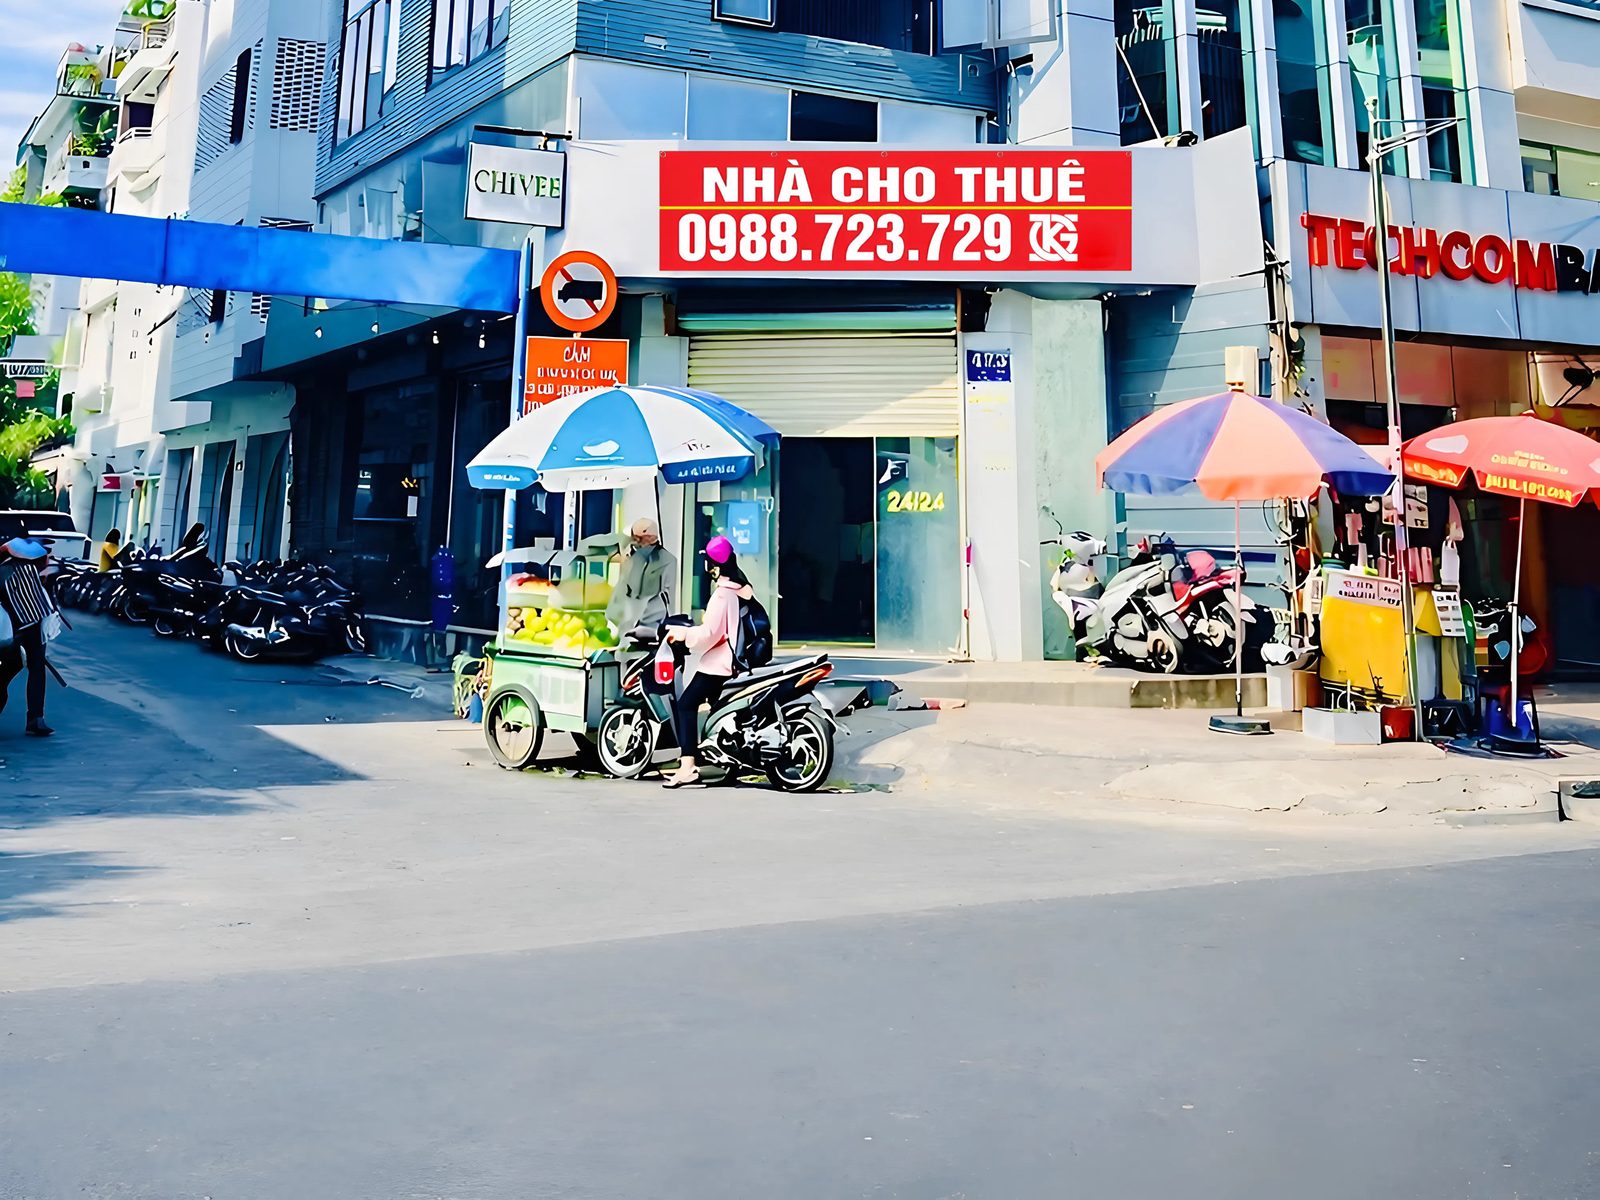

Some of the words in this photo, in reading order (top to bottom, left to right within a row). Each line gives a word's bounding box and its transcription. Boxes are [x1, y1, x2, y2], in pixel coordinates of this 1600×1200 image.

[703, 159, 812, 203] NHÀ
[831, 166, 936, 204] CHO
[954, 159, 1086, 204] THUÊ
[678, 213, 1012, 263] 0988.723.729
